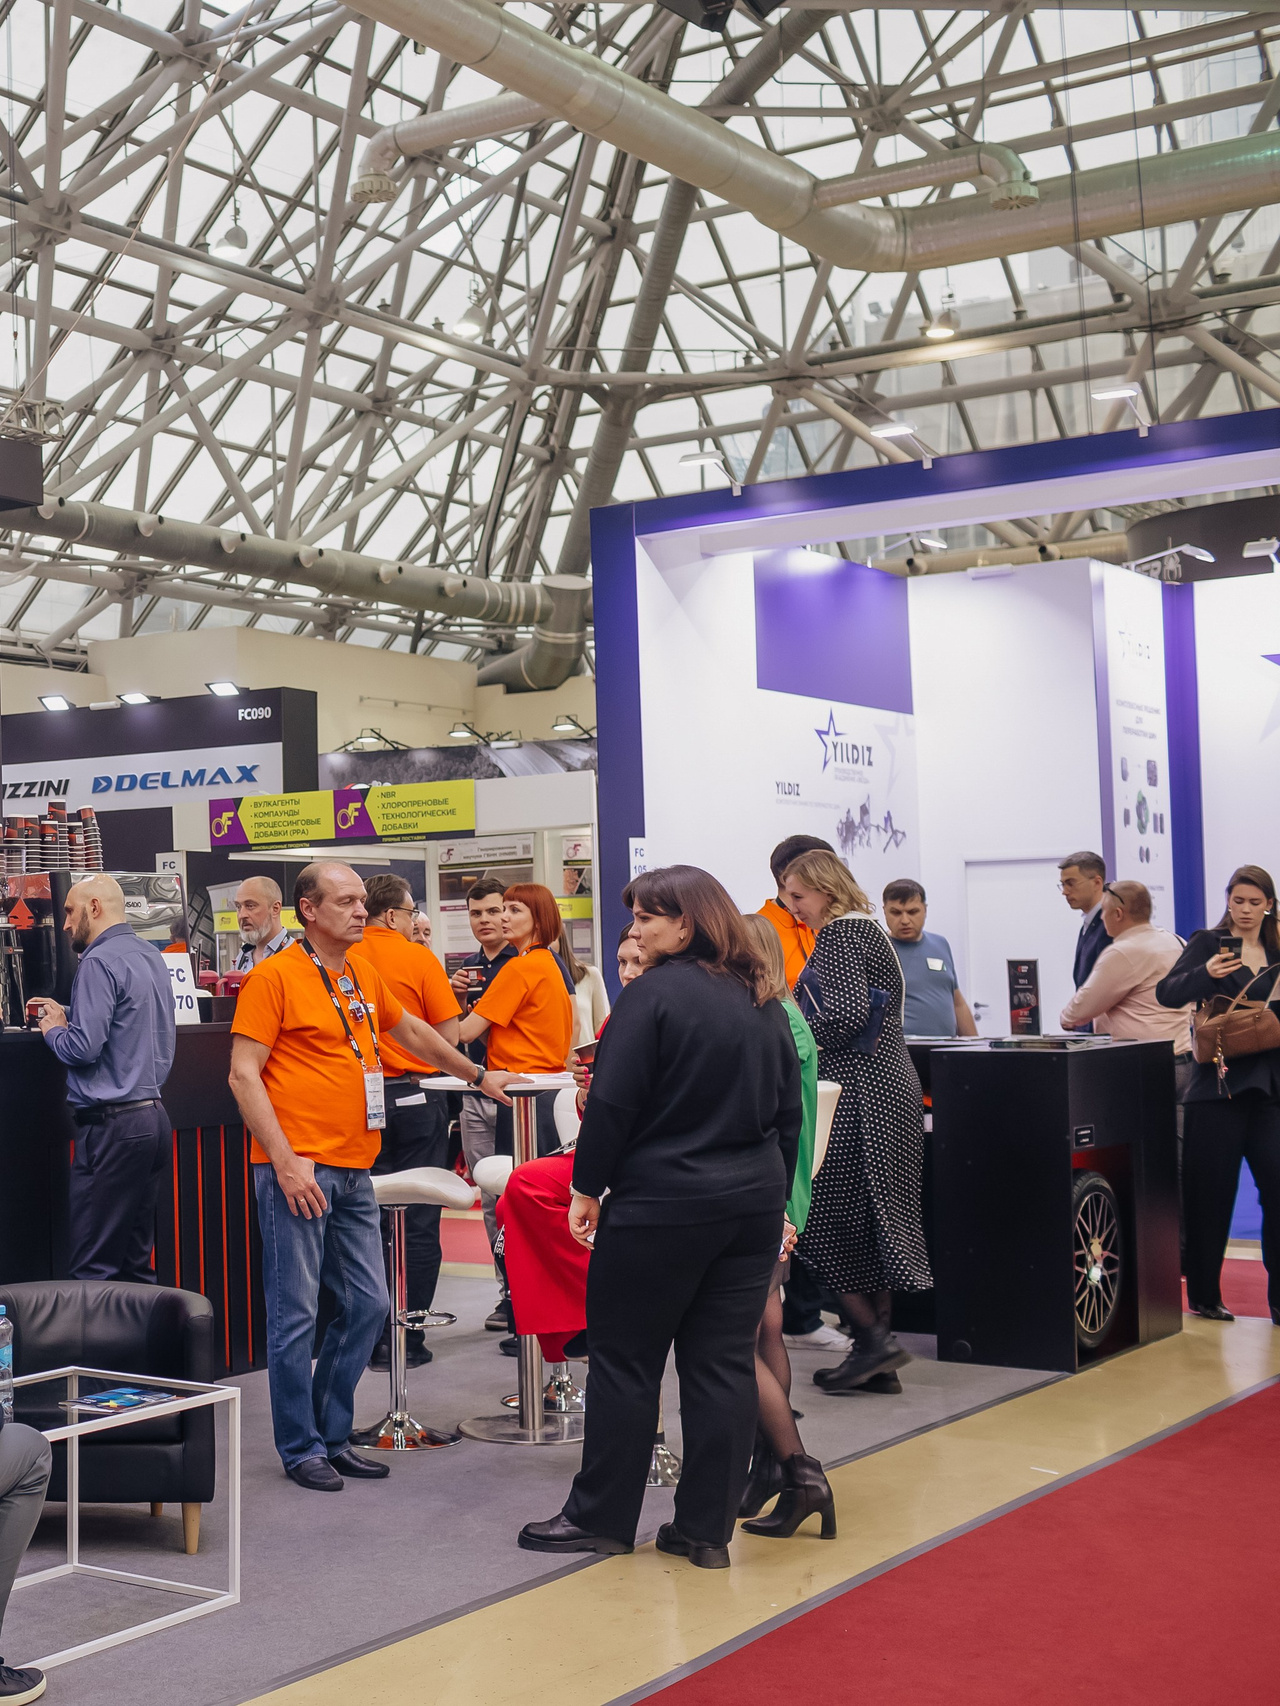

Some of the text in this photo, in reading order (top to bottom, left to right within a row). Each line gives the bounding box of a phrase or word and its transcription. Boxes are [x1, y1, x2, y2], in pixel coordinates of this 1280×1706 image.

[237, 706, 272, 721] FC090
[832, 741, 873, 767] YILDIZ
[115, 764, 260, 792] DELMAX
[775, 781, 801, 796] YILDIZ
[380, 791, 397, 799] NBR
[253, 799, 300, 809] ВУЛКАГЕНТЫ
[381, 798, 449, 810] ХЛОРОПРЕНОВЫЕ
[254, 809, 300, 819] КОМПАУНДЫ
[381, 808, 457, 820] ТЕХНОЛОГИЧЕСКИЕ
[254, 818, 321, 829] ПРОЦЕССИНГОВЫЕ
[381, 822, 419, 832] ДОБАВКИ
[254, 830, 288, 839] ДОБАВКИ
[634, 848, 645, 857] FC
[162, 861, 176, 870] FC
[175, 994, 194, 1010] 70
